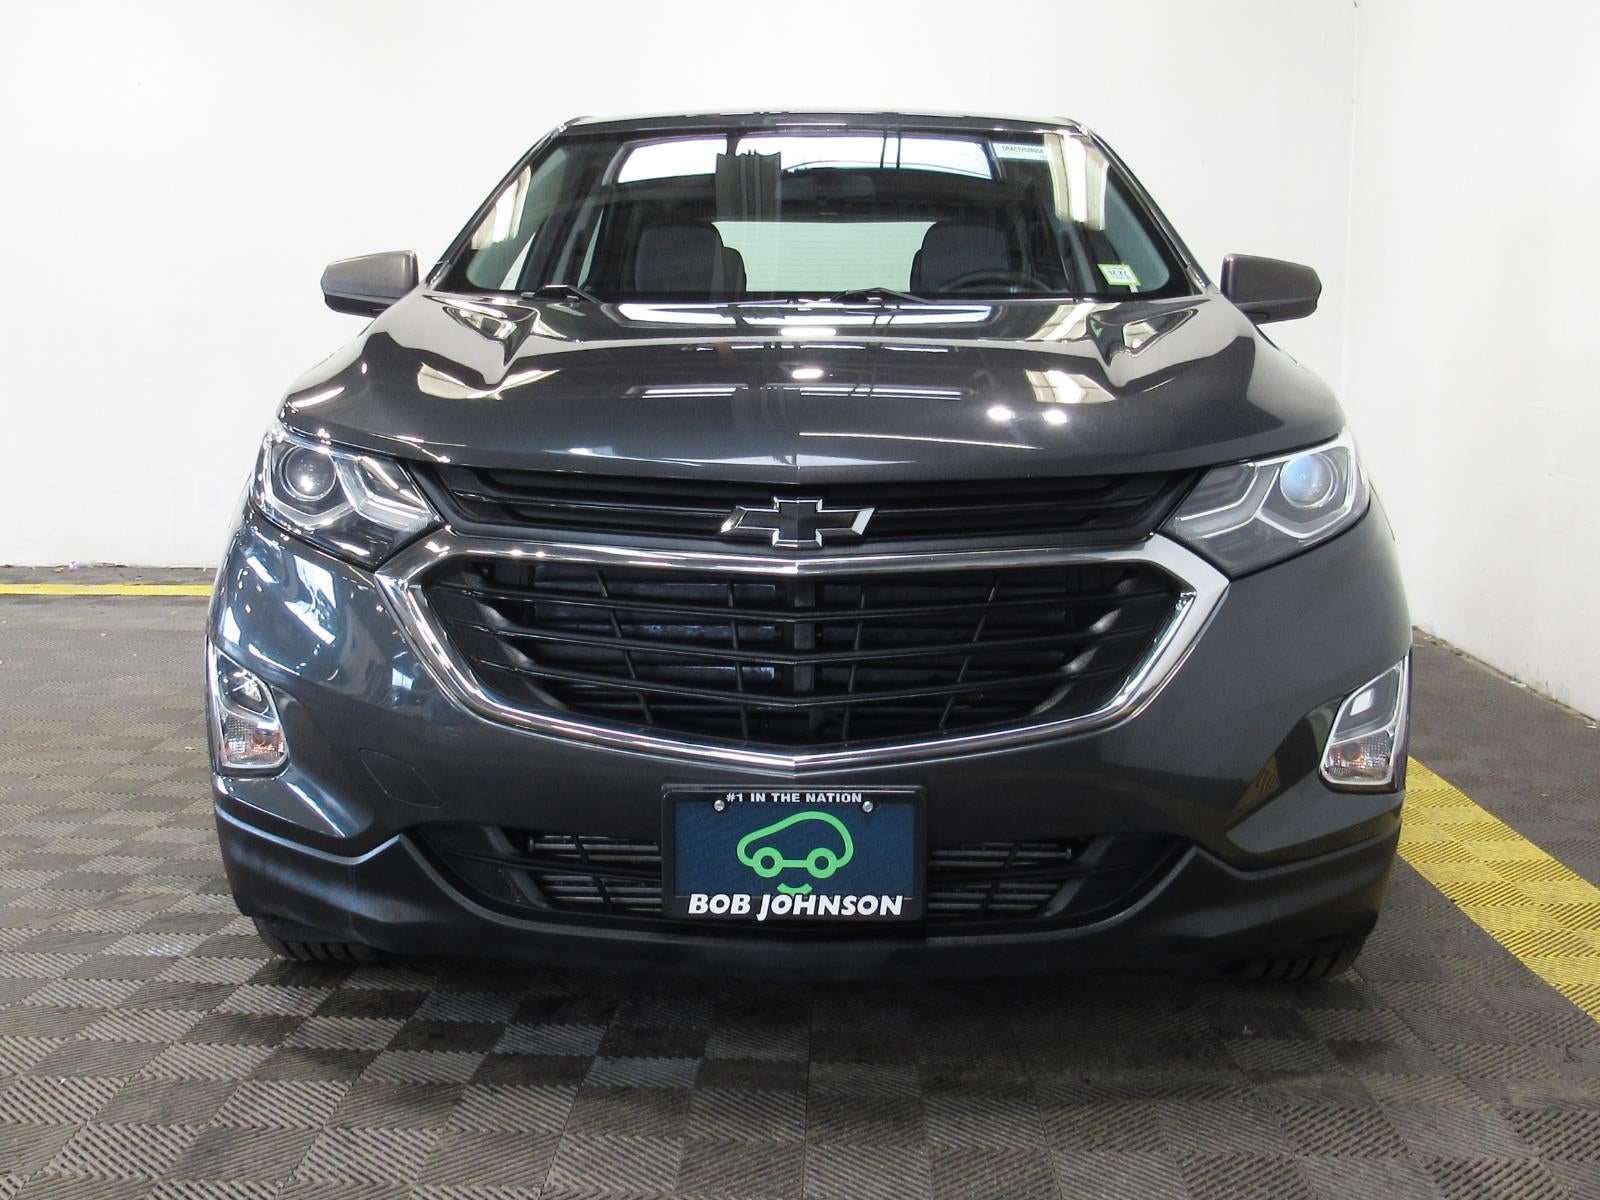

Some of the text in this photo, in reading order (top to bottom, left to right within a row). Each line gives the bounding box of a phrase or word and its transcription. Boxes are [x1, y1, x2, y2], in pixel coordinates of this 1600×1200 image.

[726, 792, 862, 803] #1 IN THE NATION
[688, 893, 903, 922] BOB JOHNSON
